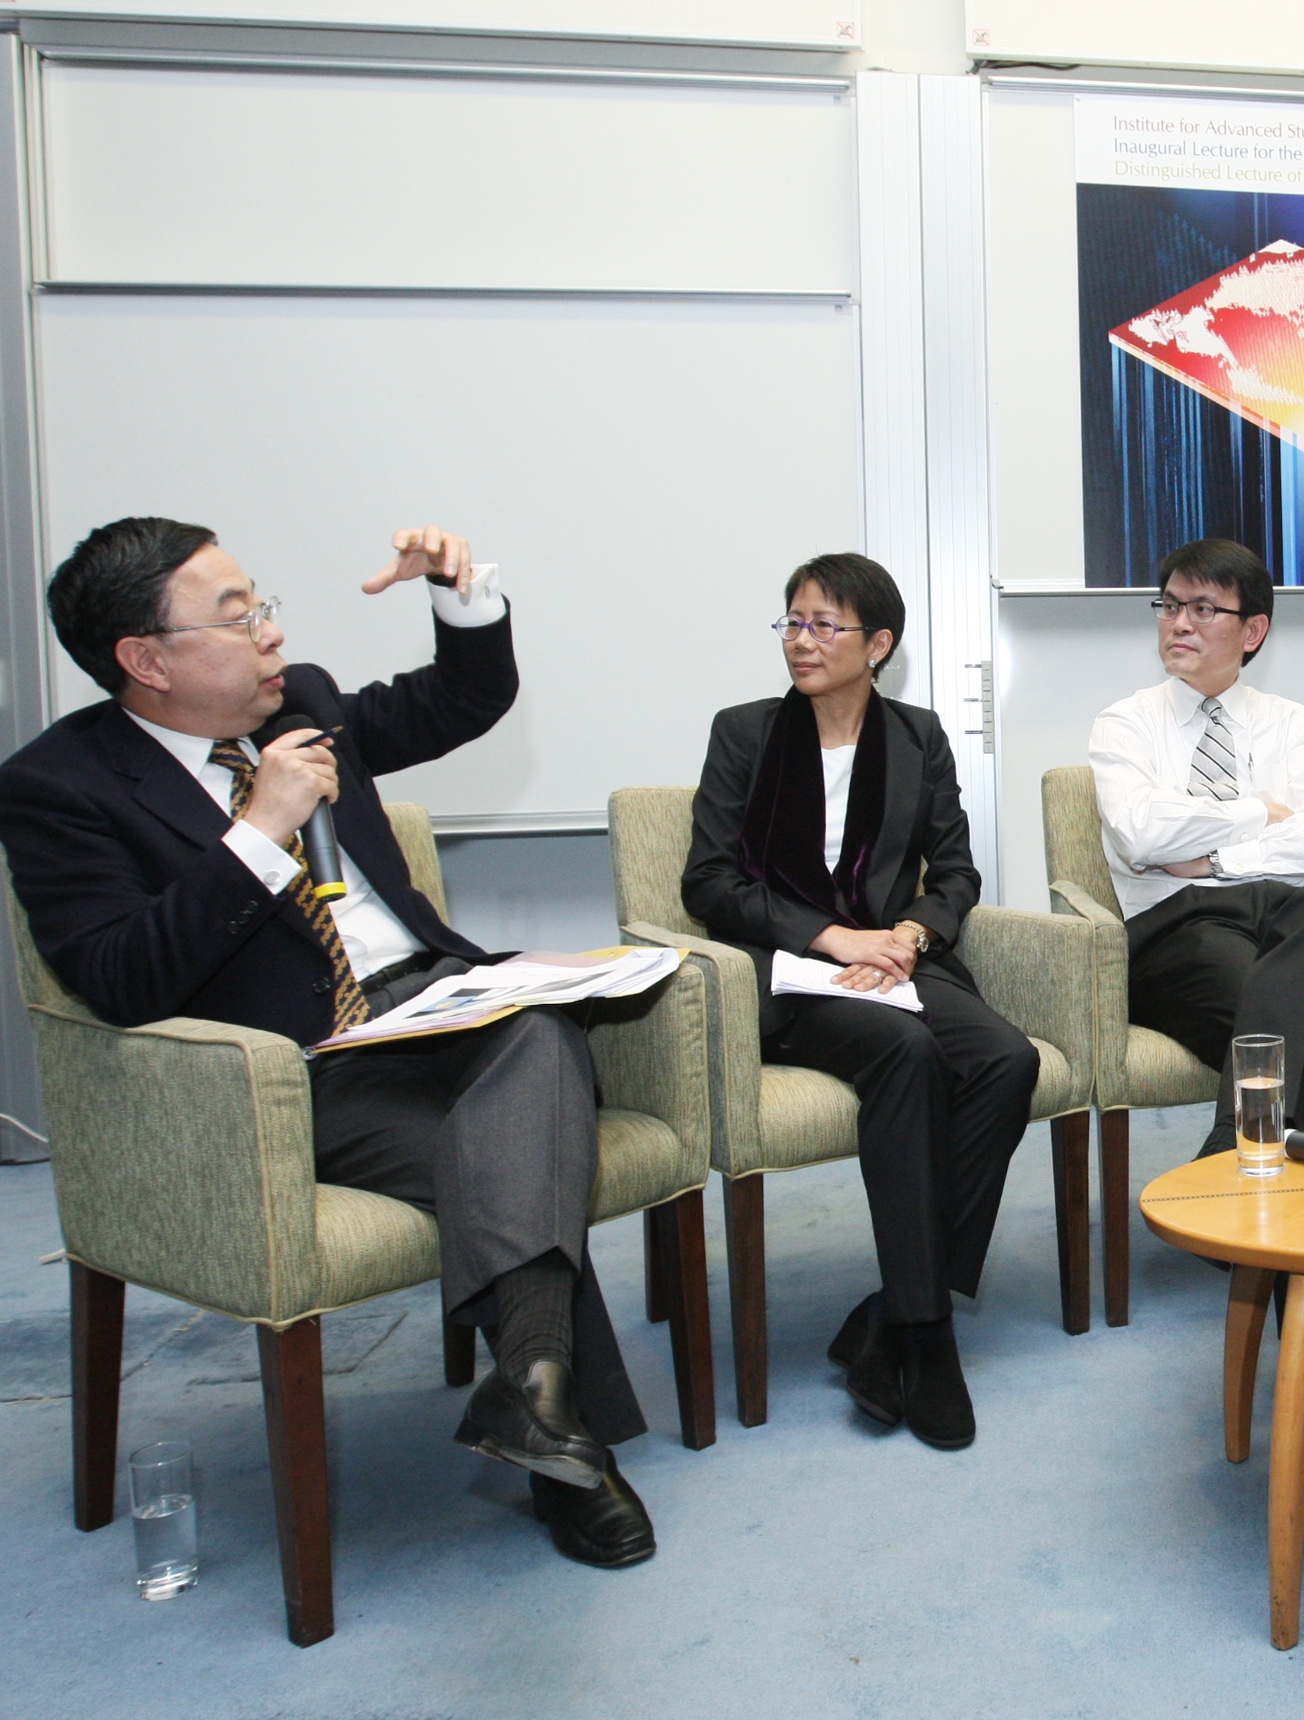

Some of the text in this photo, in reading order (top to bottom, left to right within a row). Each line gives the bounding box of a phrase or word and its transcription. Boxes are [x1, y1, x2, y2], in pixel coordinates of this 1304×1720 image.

[1113, 115, 1175, 133] Institute
[1179, 118, 1200, 134] for
[1205, 119, 1283, 138] Advanced
[1114, 137, 1187, 158] Inaugural
[1192, 141, 1249, 159] Lecture
[1252, 144, 1273, 160] for
[1278, 145, 1303, 161] the
[1114, 160, 1222, 181] Distinguished
[1226, 165, 1283, 183] Lecture
[1286, 167, 1302, 183] of
